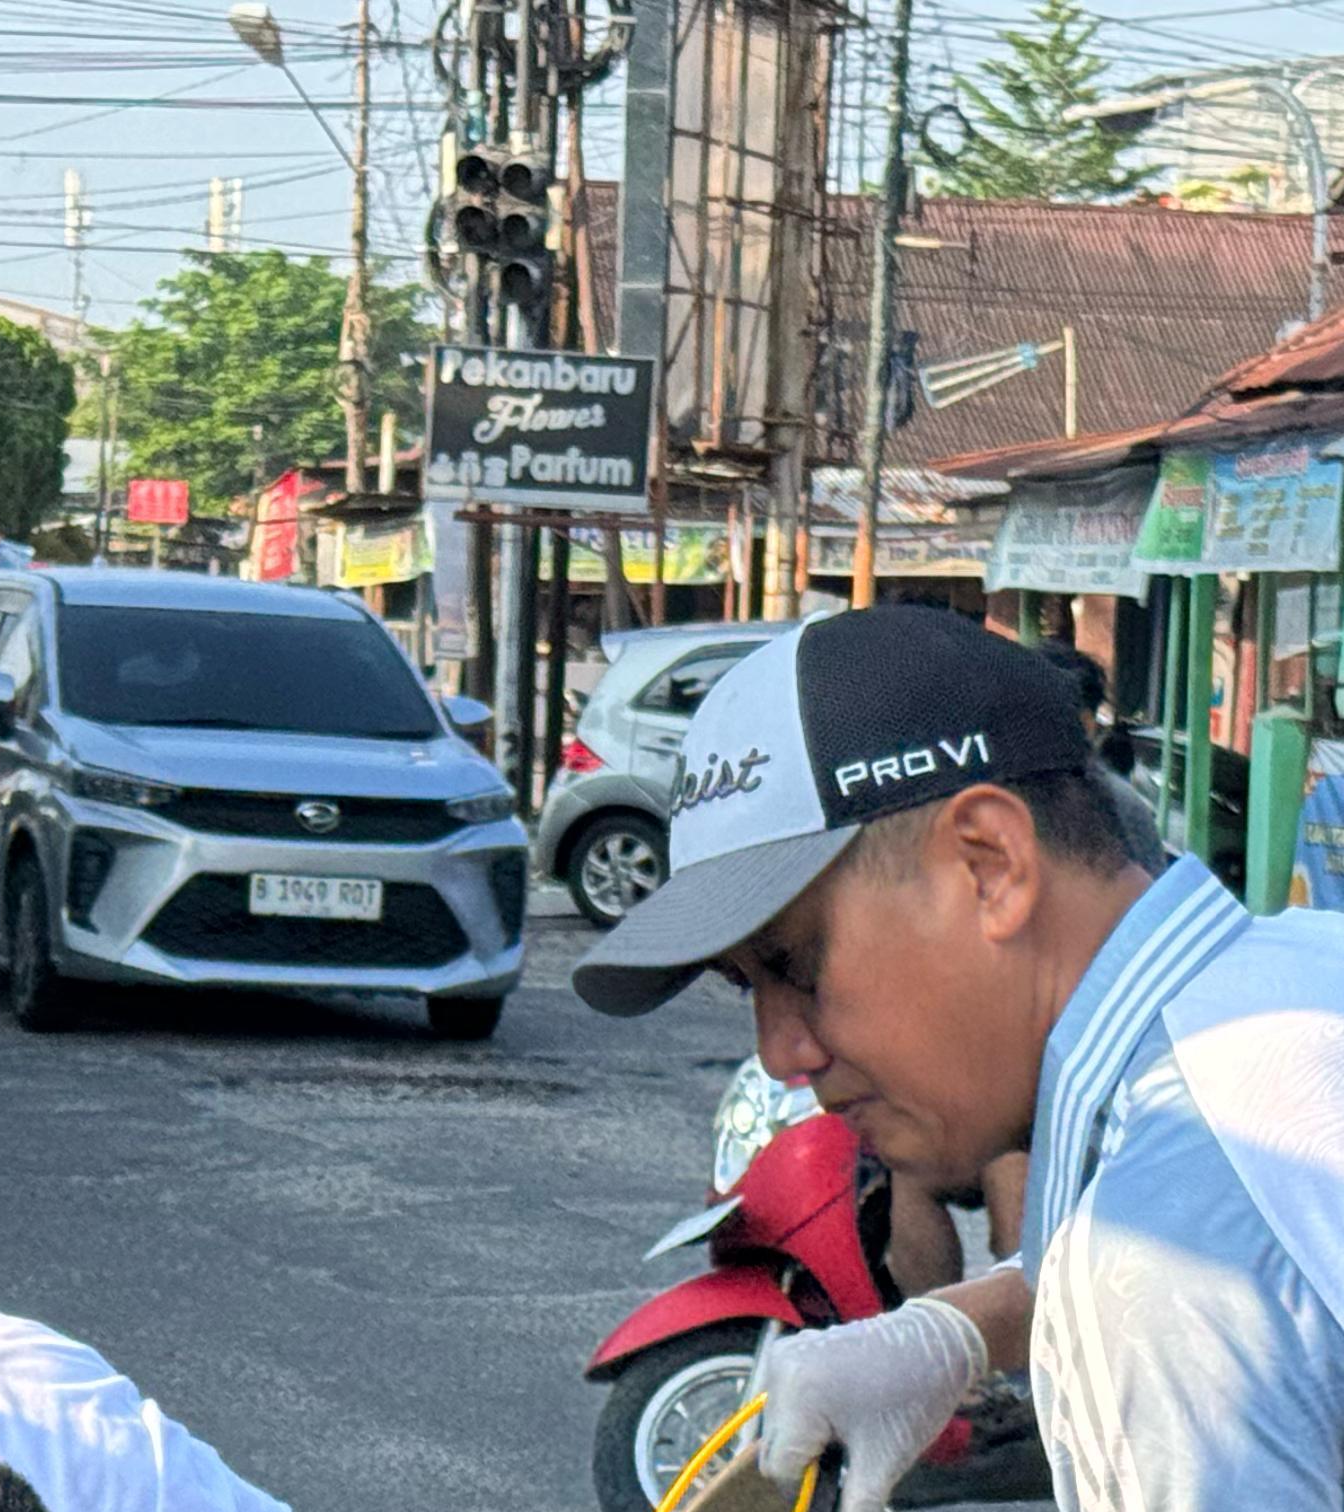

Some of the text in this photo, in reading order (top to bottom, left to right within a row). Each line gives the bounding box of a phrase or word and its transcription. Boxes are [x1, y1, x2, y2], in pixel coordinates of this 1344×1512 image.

[440, 350, 637, 396] Pekanbaru
[511, 444, 634, 487] Parfum
[834, 733, 992, 797] PRO V1
